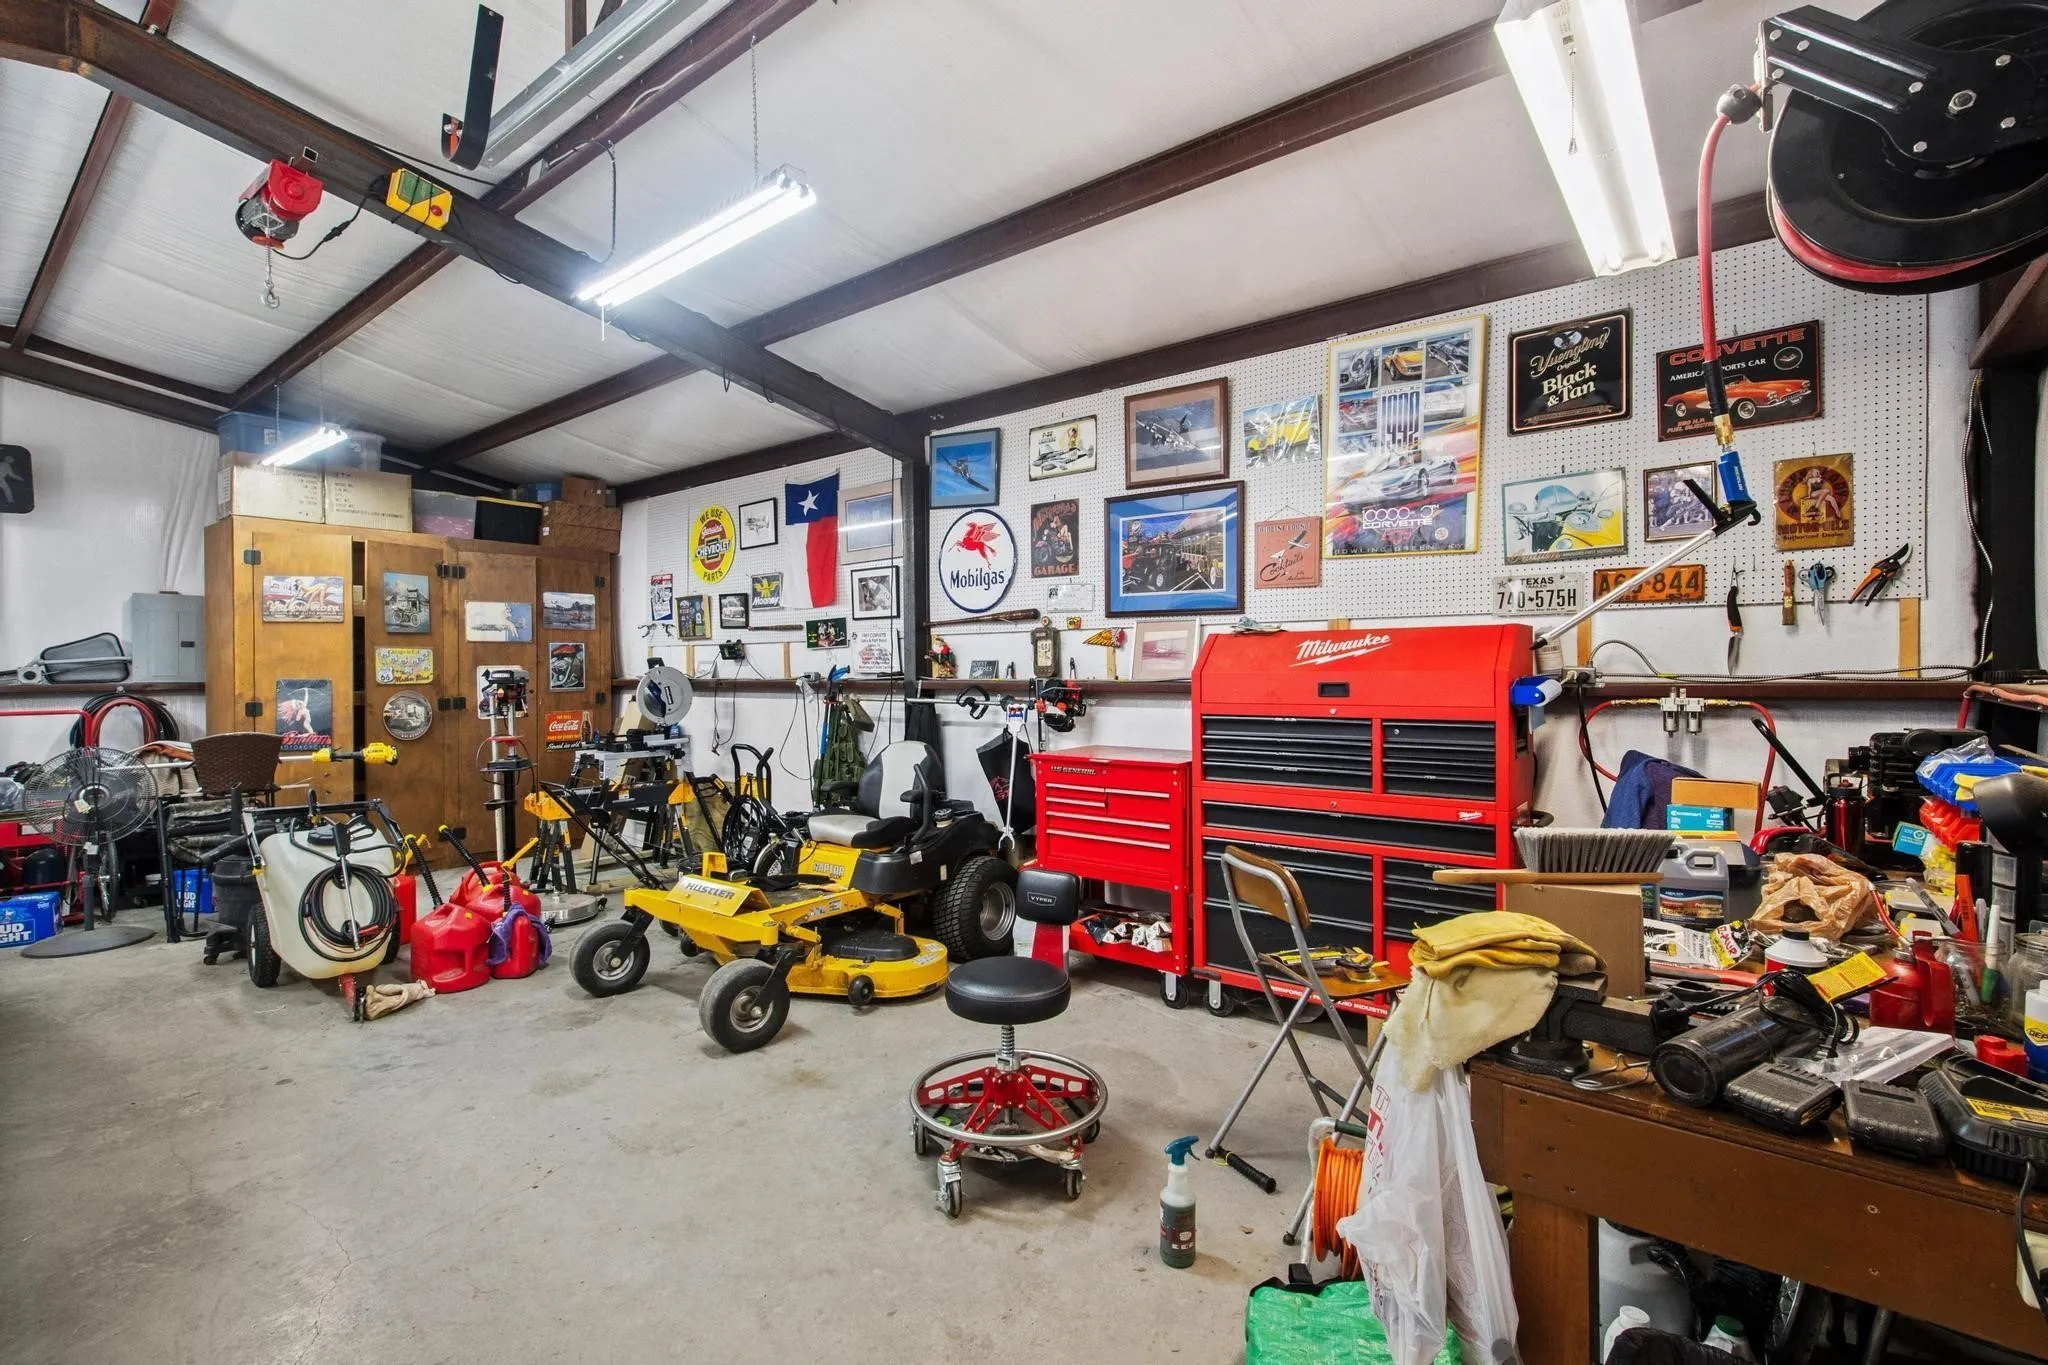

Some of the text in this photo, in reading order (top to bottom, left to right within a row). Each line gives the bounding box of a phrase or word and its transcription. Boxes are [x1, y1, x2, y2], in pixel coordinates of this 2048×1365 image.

[1530, 327, 1611, 378] Yuengling
[1669, 327, 1807, 366] COVETTE
[1748, 358, 1767, 367] CAR
[1542, 362, 1597, 395] Black
[1547, 381, 1596, 407] & Tan
[700, 508, 723, 524] WE USE
[1362, 517, 1433, 529] CORVETTE
[696, 539, 731, 557] CHEVROLET
[1034, 564, 1075, 576] GARAGE
[1260, 552, 1304, 582] Cocktails
[703, 569, 724, 582] PARTS
[950, 568, 1005, 590] Mobilgas
[1520, 576, 1554, 585] TEXAS
[266, 600, 340, 614] Yellow Rose
[752, 597, 780, 606] Mooney
[1296, 633, 1392, 660] Milwaukee
[549, 720, 579, 732] Coca-Cola
[281, 730, 332, 745] Indian
[1062, 766, 1096, 776] GENERAL
[813, 862, 845, 876] RAPTOR
[177, 891, 196, 901] UD
[685, 882, 736, 900] HUSTLER
[176, 899, 197, 908] LGHT
[1030, 895, 1053, 903] VYPER
[0, 923, 24, 934] UD
[0, 930, 32, 944] GHT
[1354, 1004, 1388, 1015] INDUSTRI
